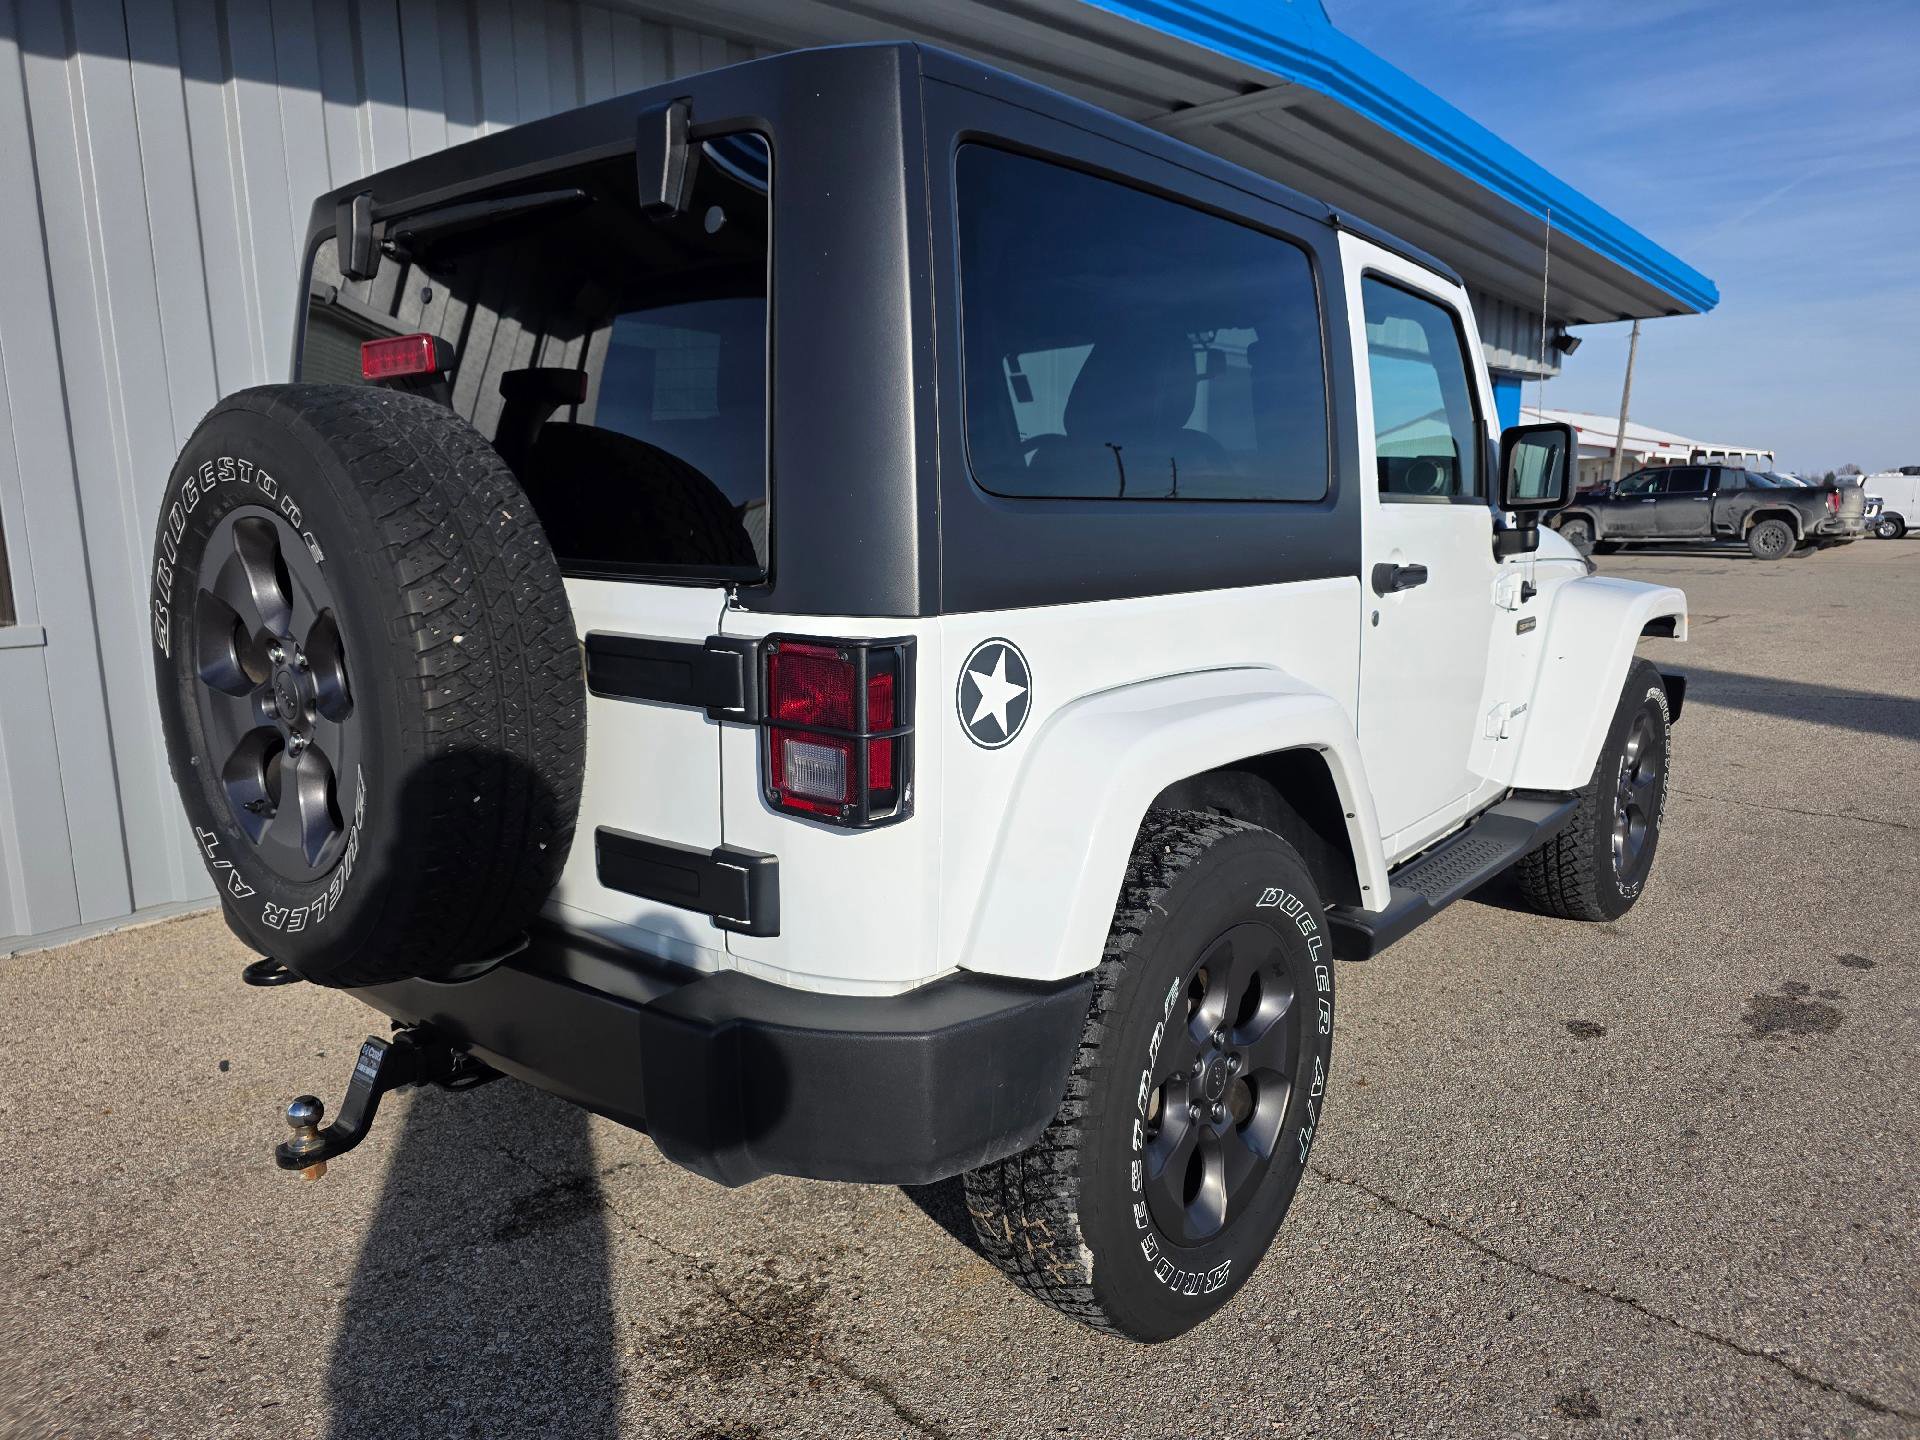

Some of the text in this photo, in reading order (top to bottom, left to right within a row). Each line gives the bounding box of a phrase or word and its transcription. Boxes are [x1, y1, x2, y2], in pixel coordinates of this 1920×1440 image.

[155, 457, 325, 659] BRIDGESTONE
[196, 764, 366, 932] DUELER A/T
[1131, 976, 1231, 1295] BRIDGESTONE
[1256, 888, 1330, 1163] DUELER A/T
